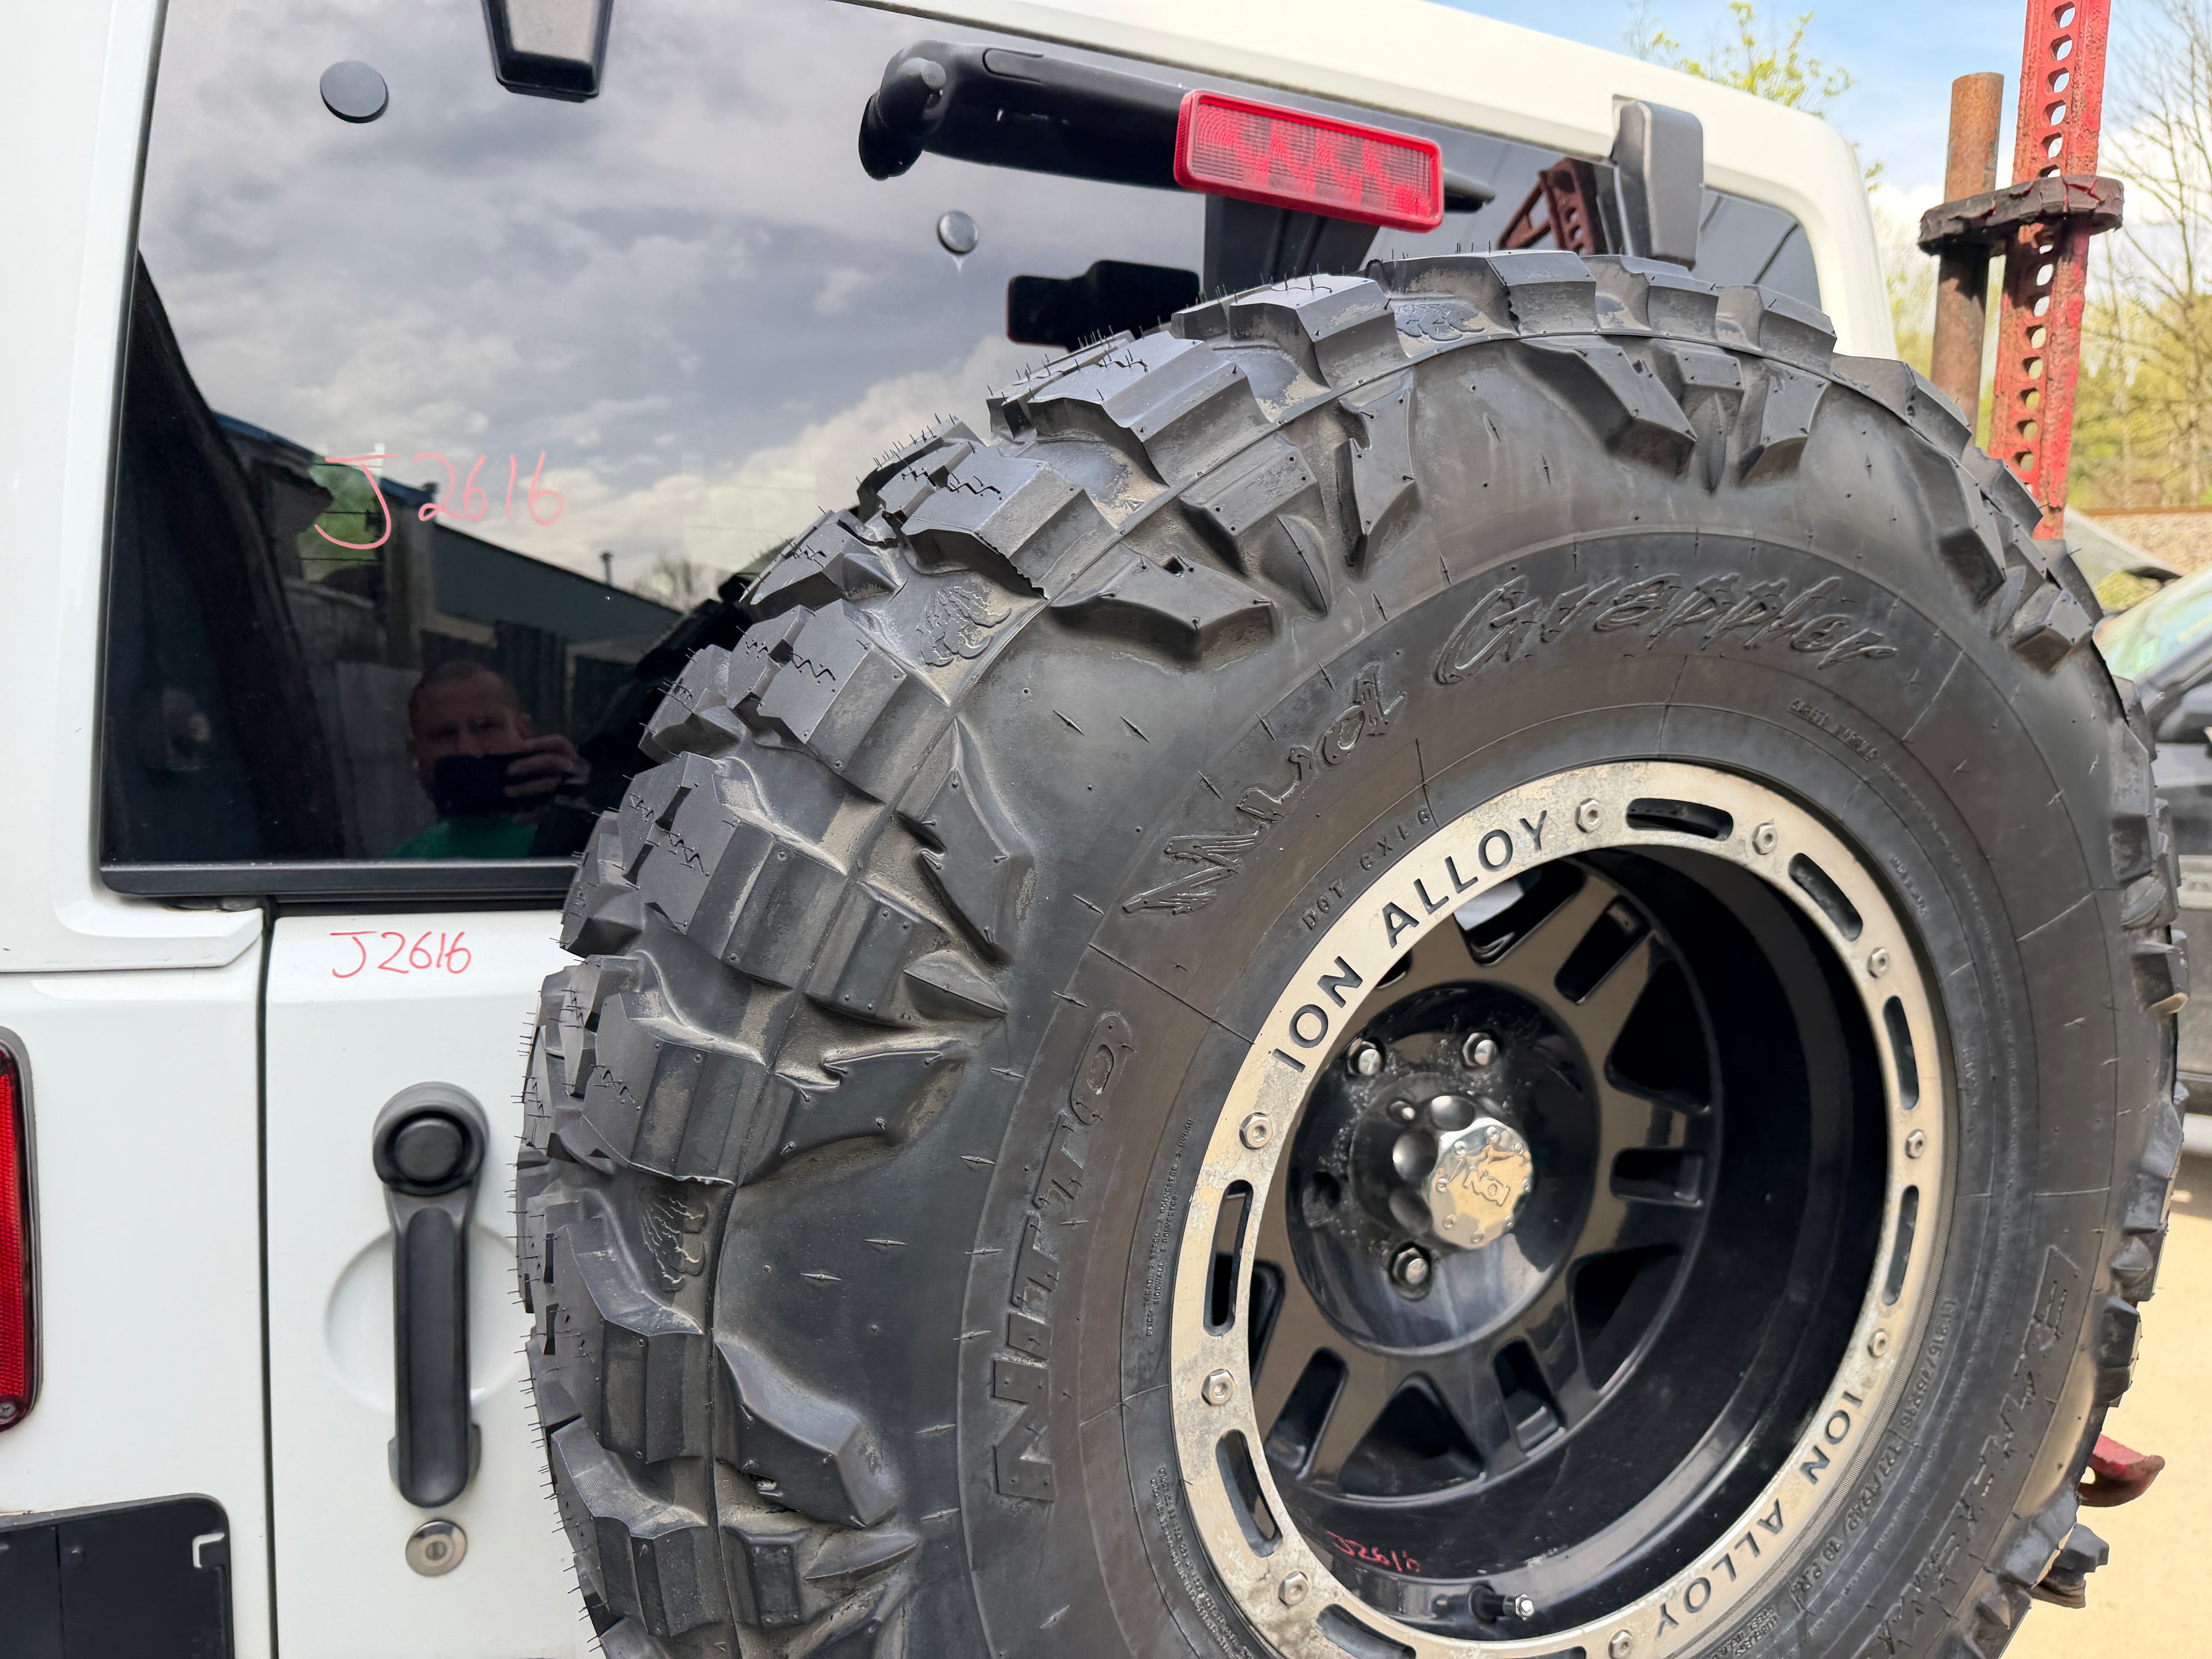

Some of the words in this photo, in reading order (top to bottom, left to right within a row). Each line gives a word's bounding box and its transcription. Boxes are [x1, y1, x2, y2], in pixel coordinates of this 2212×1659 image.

[315, 452, 565, 550] J2616
[1122, 661, 1410, 915] Mud
[329, 930, 472, 979] J2616
[1272, 956, 1363, 1073] ION
[1382, 809, 1548, 949] ALLOY
[1301, 878, 1345, 930] DOT
[993, 1013, 1131, 1502] NITTO
[1800, 1391, 1863, 1484] ION
[1655, 1498, 1784, 1641] ALLOY
